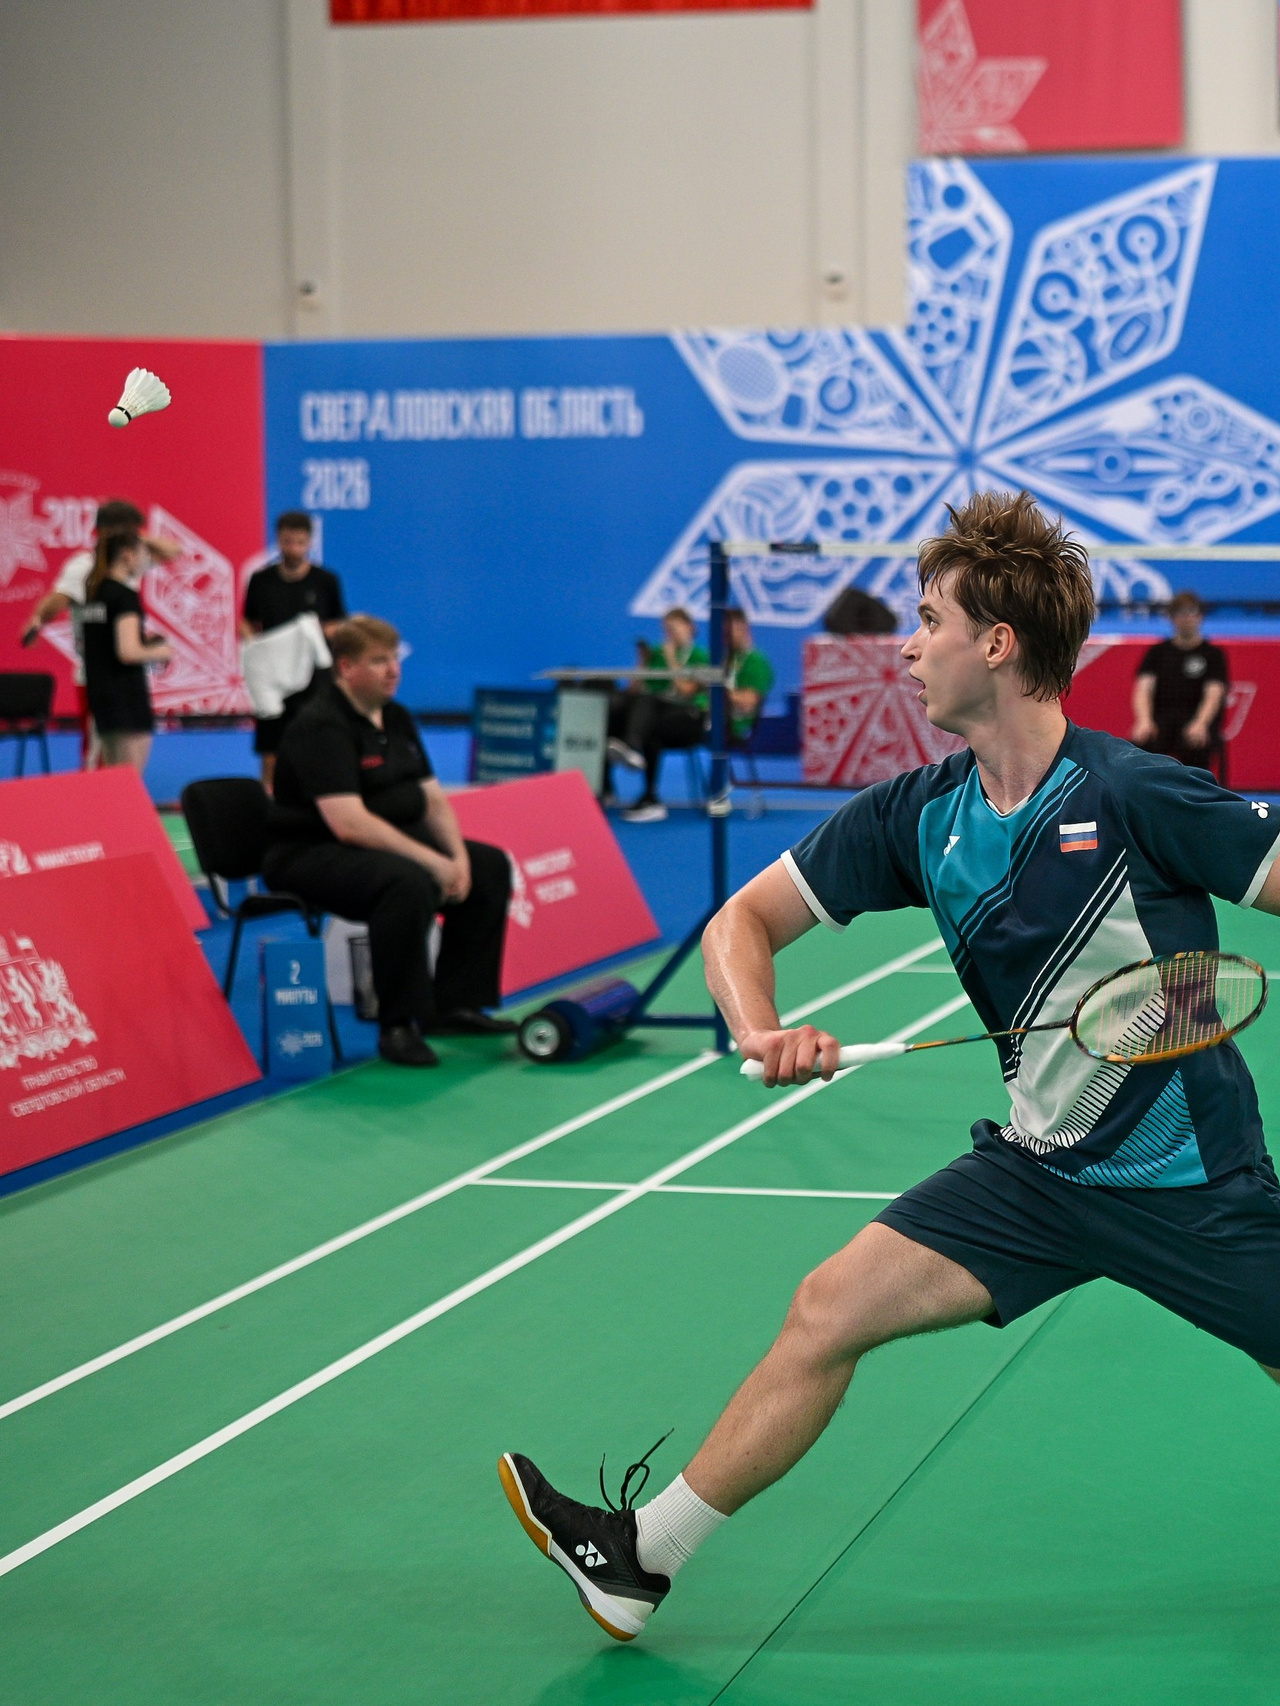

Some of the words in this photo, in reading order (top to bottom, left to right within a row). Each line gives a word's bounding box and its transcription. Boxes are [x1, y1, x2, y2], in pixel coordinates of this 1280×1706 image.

[300, 388, 516, 442] СВЕРДЛОВСКАЯ
[521, 386, 645, 439] ОБЛАСТЬ
[301, 457, 371, 511] 2026
[42, 497, 98, 550] 202
[289, 959, 301, 985] 2
[9, 1079, 85, 1117] СВЕРДЛОВСКОЙ
[84, 1067, 127, 1092] ОБЛАСТИ
[22, 1055, 98, 1091] ПРАВИТЕЛЬСТВО
